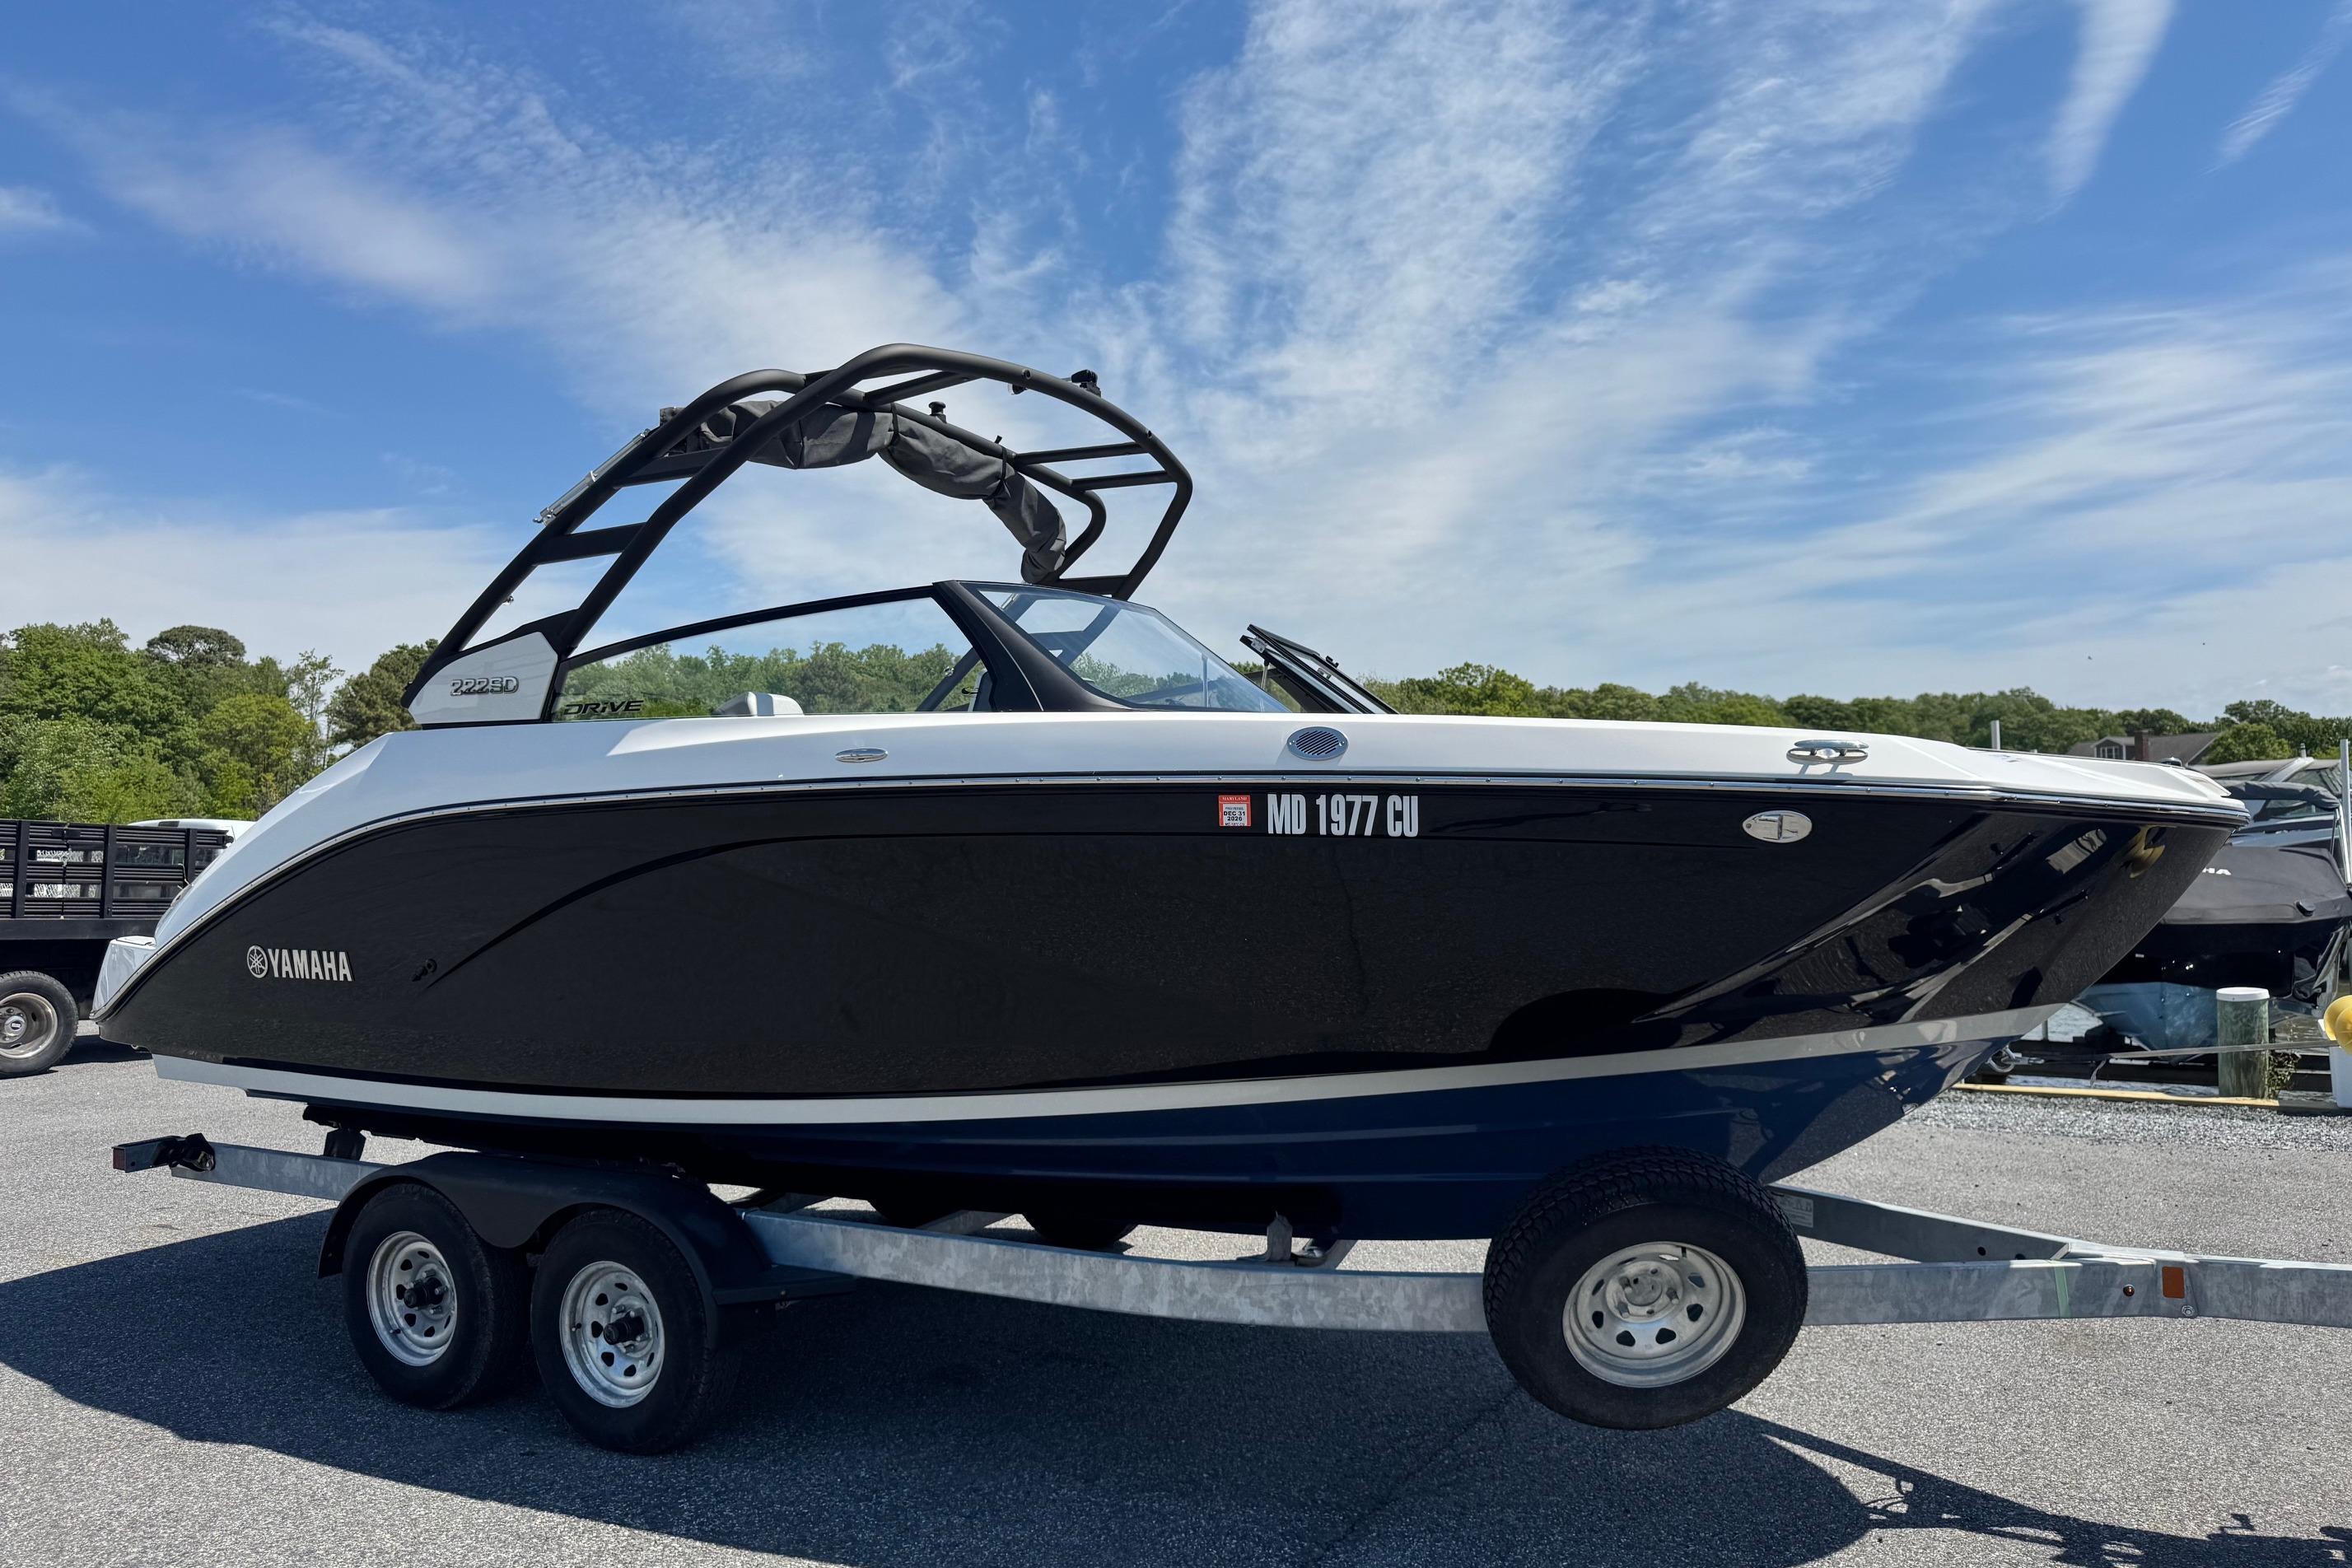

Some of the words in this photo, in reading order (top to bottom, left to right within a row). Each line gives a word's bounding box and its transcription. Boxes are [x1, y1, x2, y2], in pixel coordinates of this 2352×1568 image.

[450, 676, 520, 696] 222SD
[1267, 794, 1307, 835] MD
[1315, 794, 1379, 837] 1977
[1387, 795, 1419, 838] CU
[267, 948, 354, 982] YAMAHA
